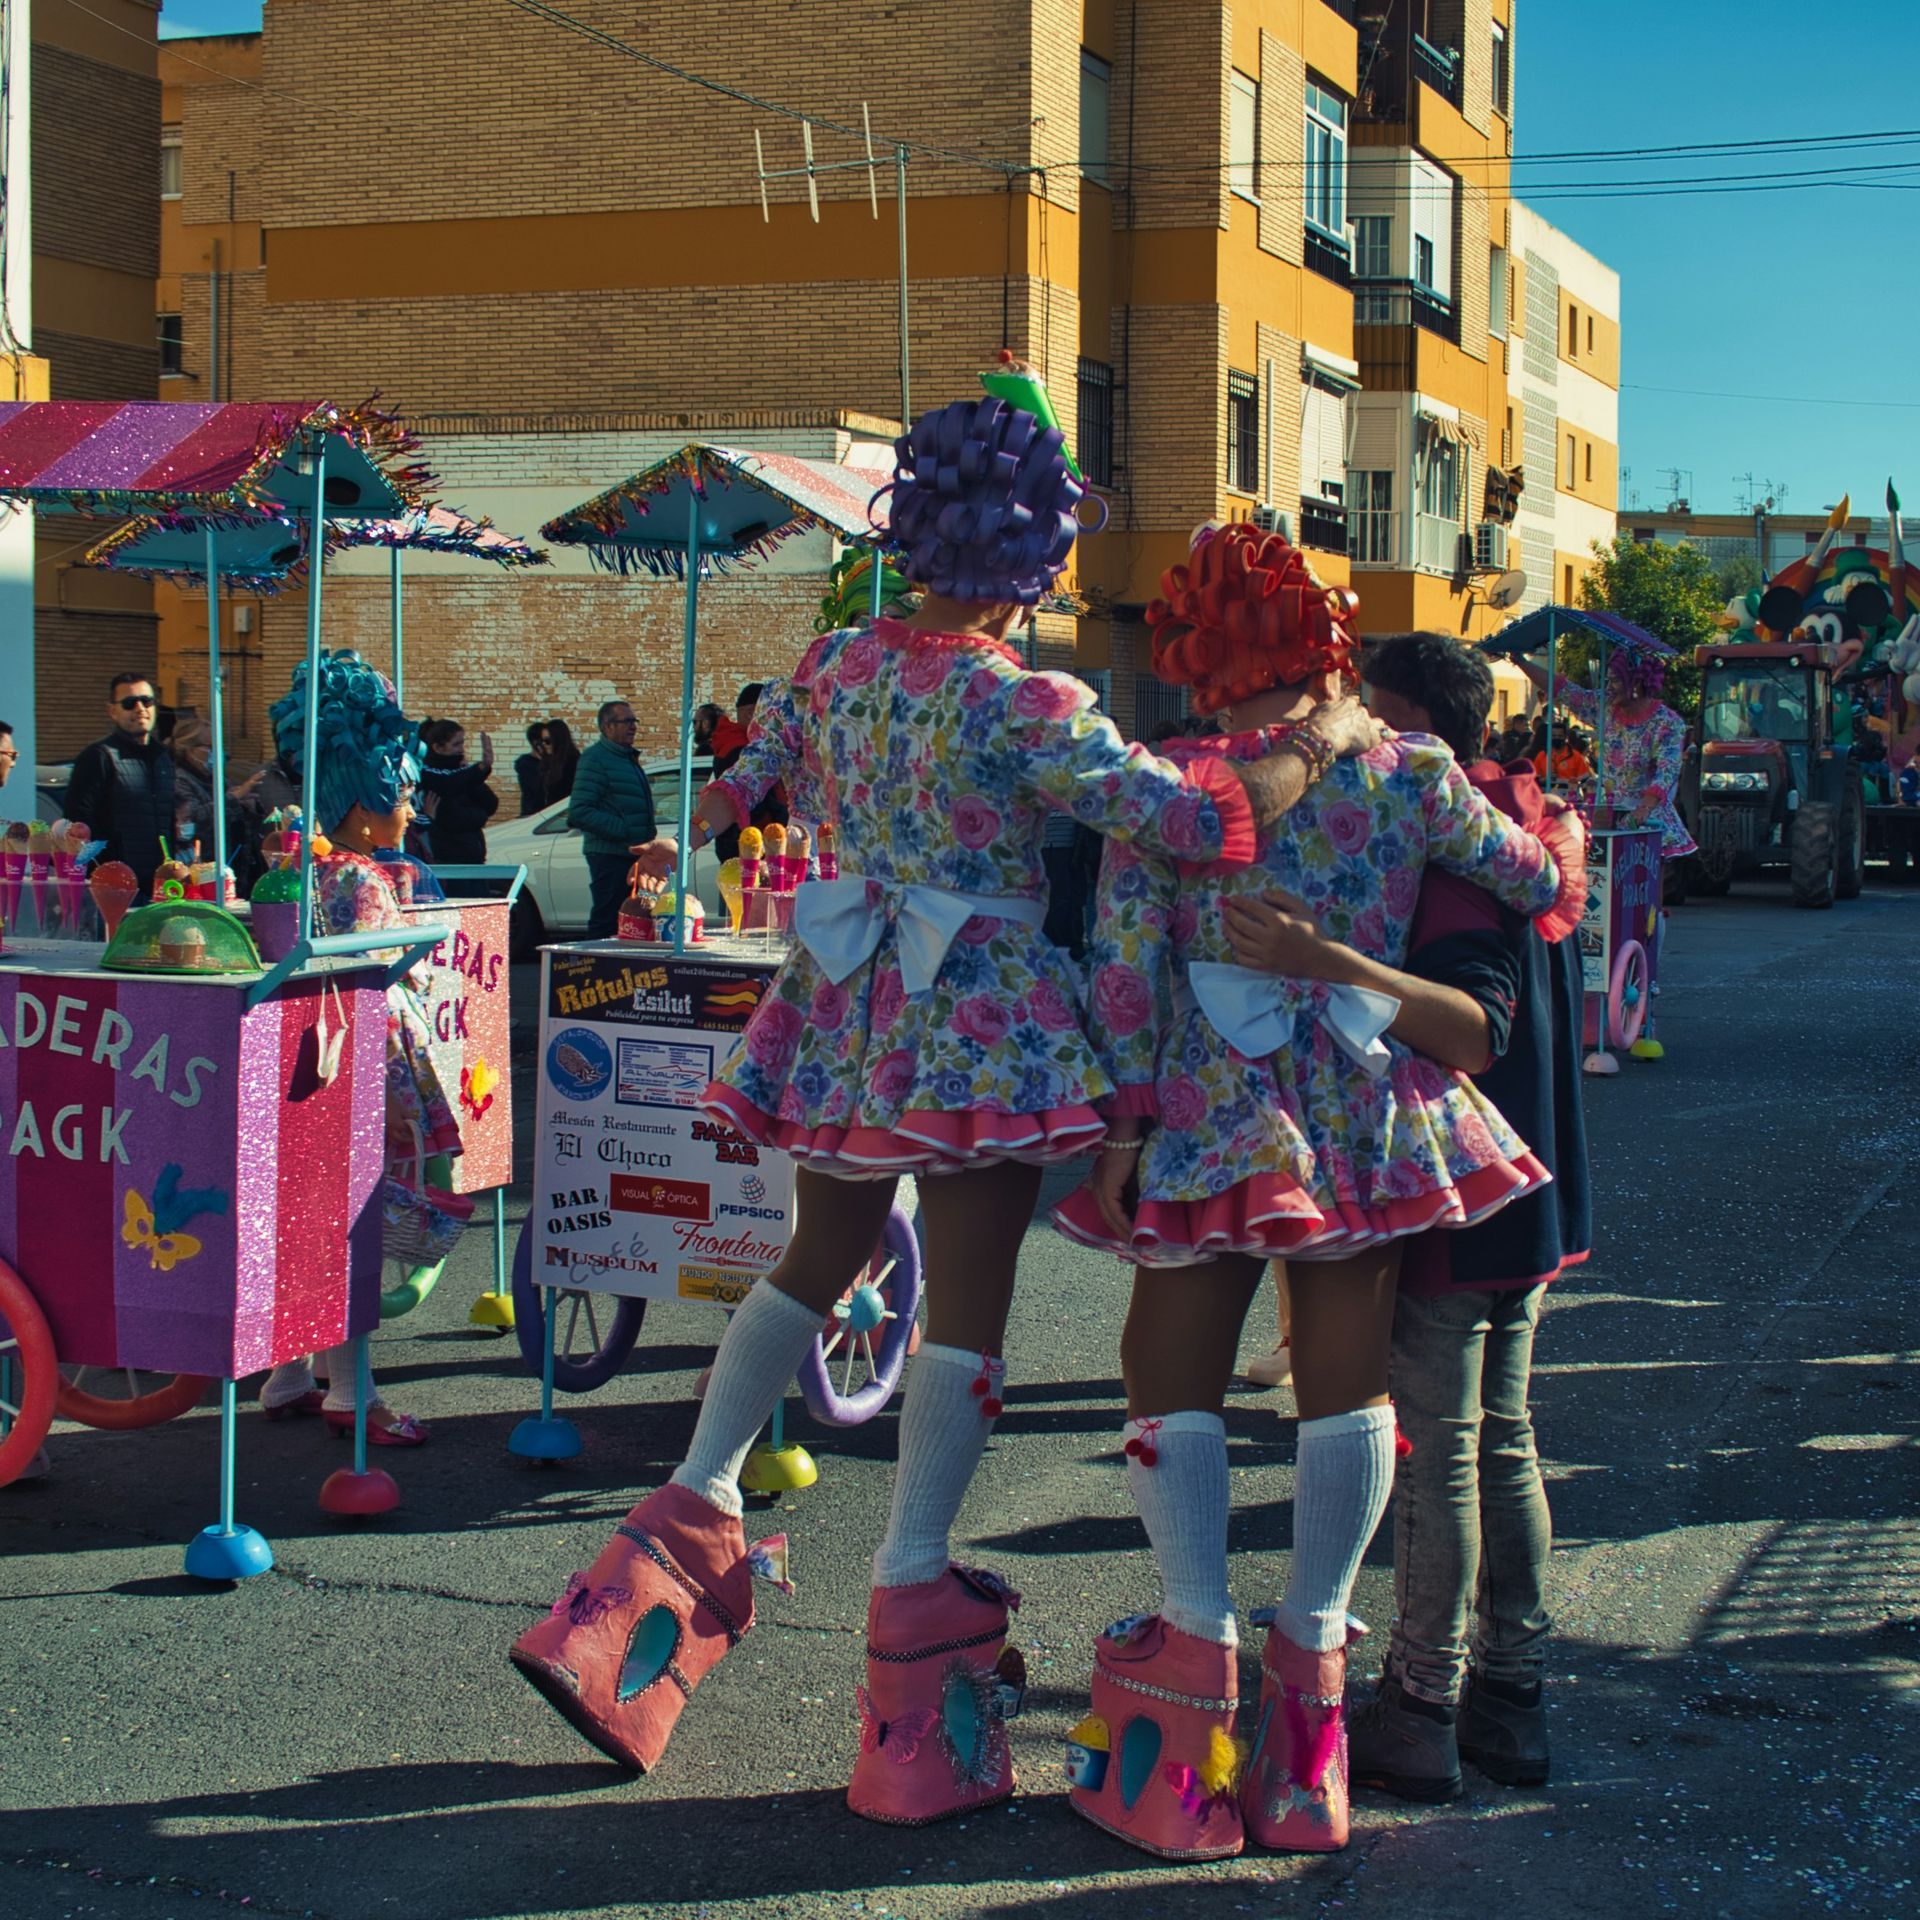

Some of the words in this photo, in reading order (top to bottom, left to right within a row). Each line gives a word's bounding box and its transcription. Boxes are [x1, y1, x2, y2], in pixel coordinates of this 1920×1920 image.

[556, 966, 669, 1015] Rótulos
[633, 988, 692, 1015] Esilut
[0, 992, 218, 1108] DERAS
[549, 1111, 595, 1128] Mesón
[602, 1115, 678, 1136] Restaurante
[553, 1132, 582, 1166] El
[597, 1138, 672, 1172] Choco
[716, 1143, 760, 1166] BAR
[550, 1187, 599, 1209] BAR
[621, 1189, 650, 1200] VISUAL
[547, 1210, 612, 1235] OASIS
[719, 1203, 784, 1221] PEPSICO
[672, 1220, 785, 1263] Frontera
